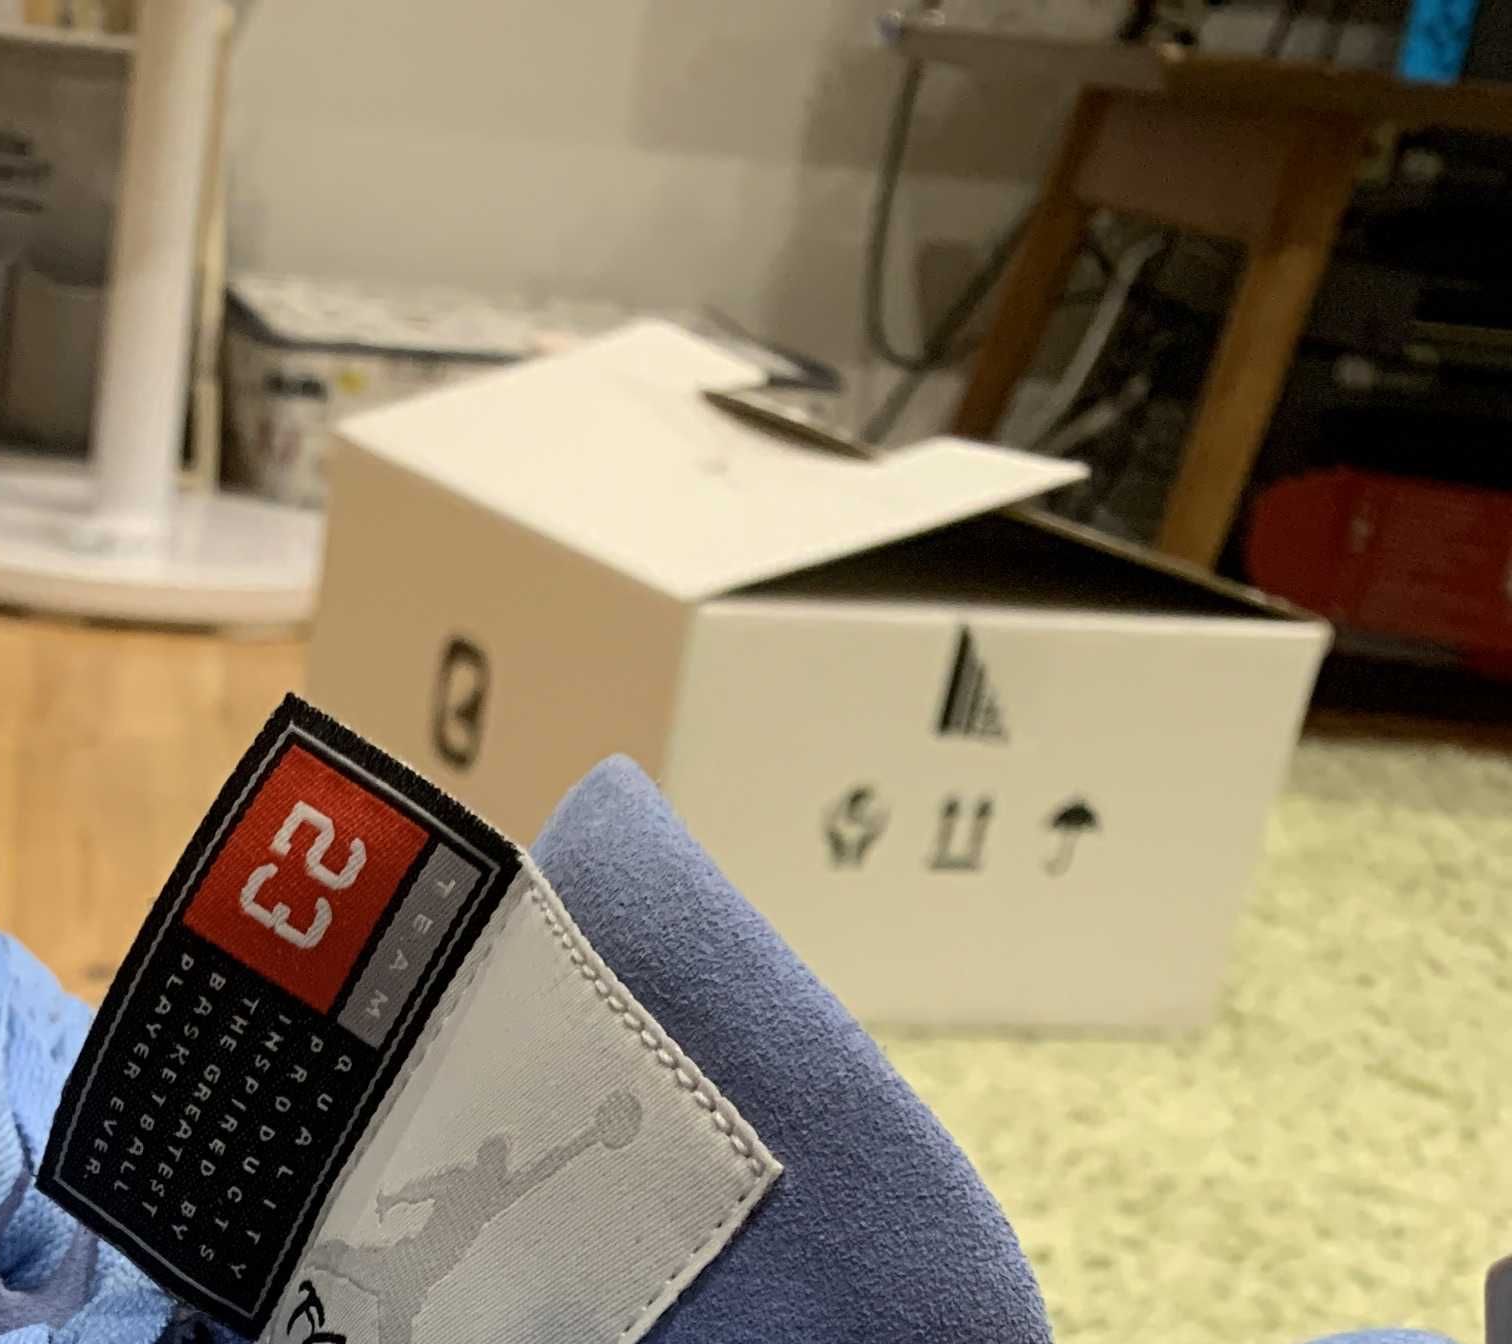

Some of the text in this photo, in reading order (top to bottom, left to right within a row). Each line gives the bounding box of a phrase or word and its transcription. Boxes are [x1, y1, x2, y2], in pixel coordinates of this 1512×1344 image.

[239, 799, 368, 949] 23
[365, 878, 457, 1020] TEAM
[113, 972, 228, 1193] BASKETBALL
[123, 952, 195, 1080] PLAYER
[141, 997, 261, 1218] THE GREATEST
[171, 1013, 293, 1241] INSPIRED BY
[199, 1035, 325, 1262] PRODUCTS
[230, 1054, 353, 1280] QUALITY
